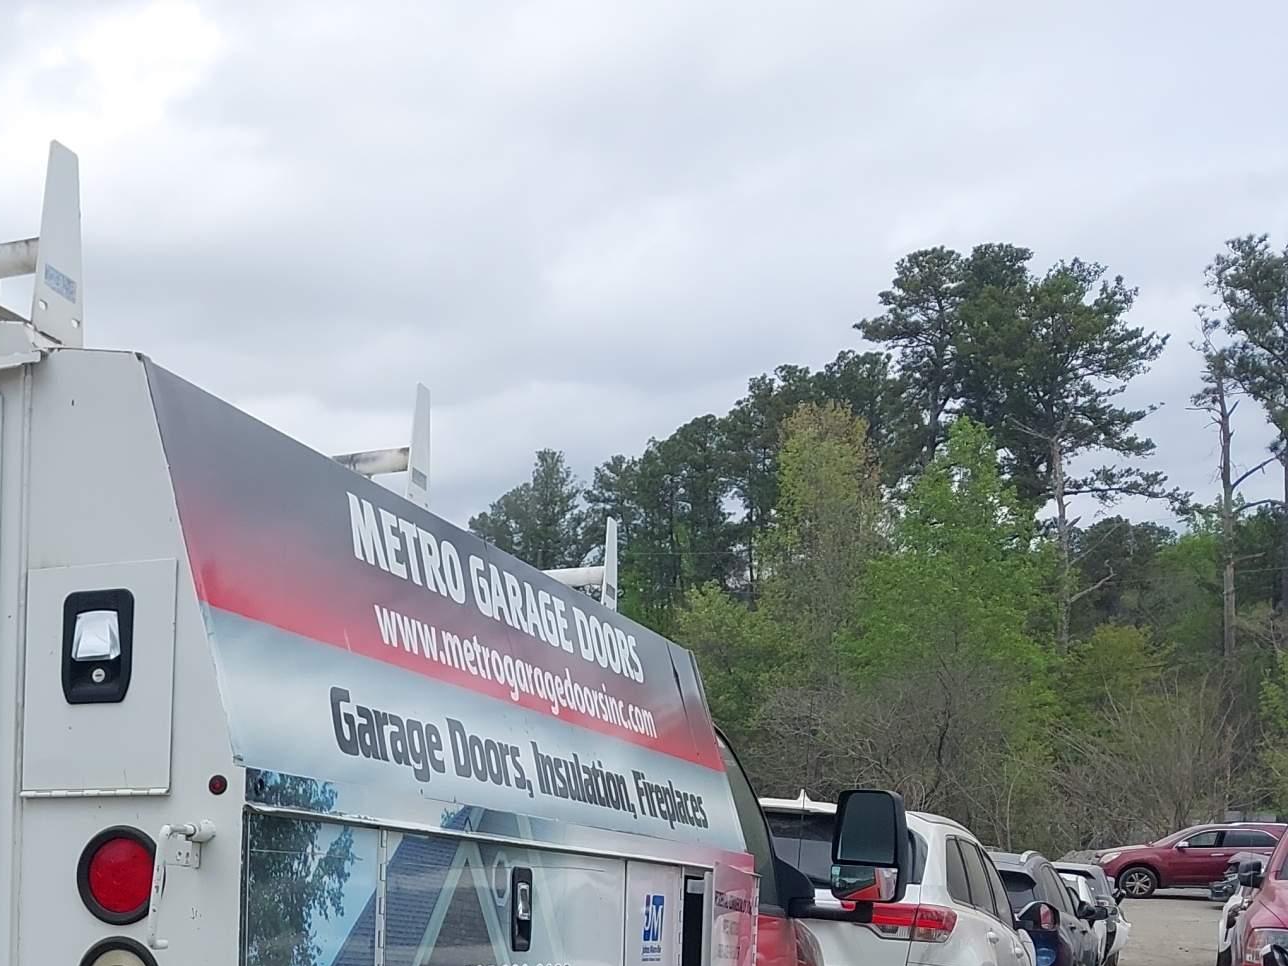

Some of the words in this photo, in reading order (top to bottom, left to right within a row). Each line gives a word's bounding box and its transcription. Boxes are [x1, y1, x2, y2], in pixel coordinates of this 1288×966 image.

[346, 491, 466, 605] METRO
[469, 553, 574, 654] GARAGE
[572, 605, 644, 684] DOORS
[373, 605, 658, 739] www.metrogaragedoorsinc.com
[329, 686, 446, 783] Garage
[446, 717, 534, 799] Doors,
[530, 740, 638, 820] Insulation,
[631, 769, 709, 830] Fireplaces
